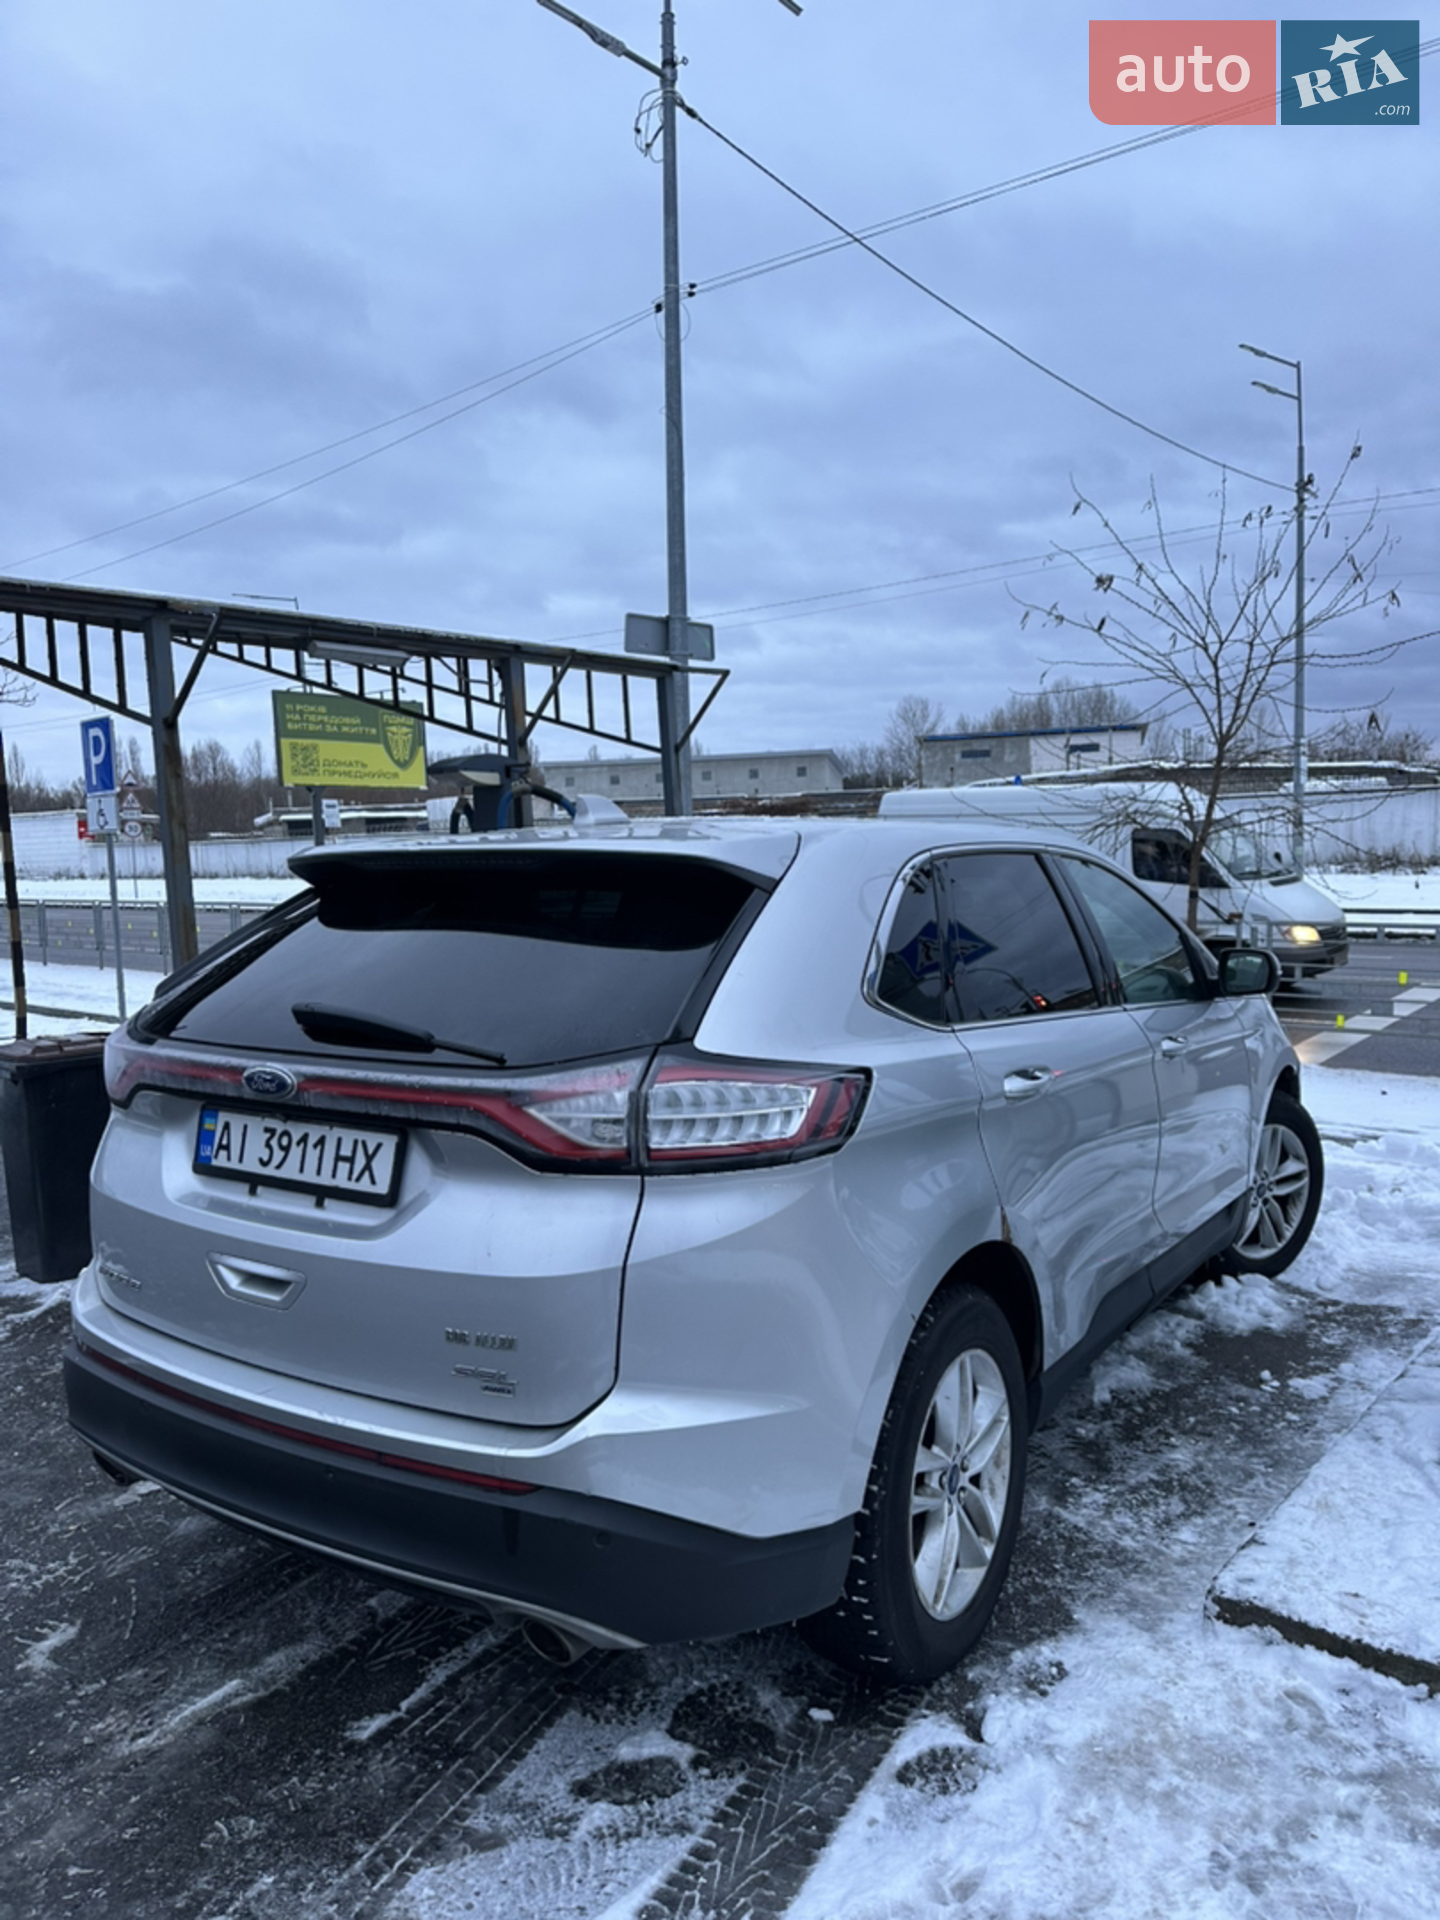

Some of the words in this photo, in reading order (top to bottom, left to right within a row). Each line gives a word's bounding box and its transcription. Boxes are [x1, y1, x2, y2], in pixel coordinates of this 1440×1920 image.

[296, 704, 327, 713] РОКІВ
[286, 713, 301, 721] НА
[287, 722, 322, 731] БИТВИ
[325, 724, 338, 732] ЗА
[341, 726, 377, 735] ЖИТТЯ
[89, 727, 105, 786] P
[250, 1073, 278, 1092] Ford
[201, 1145, 213, 1157] UA
[258, 1126, 327, 1177] 3911
